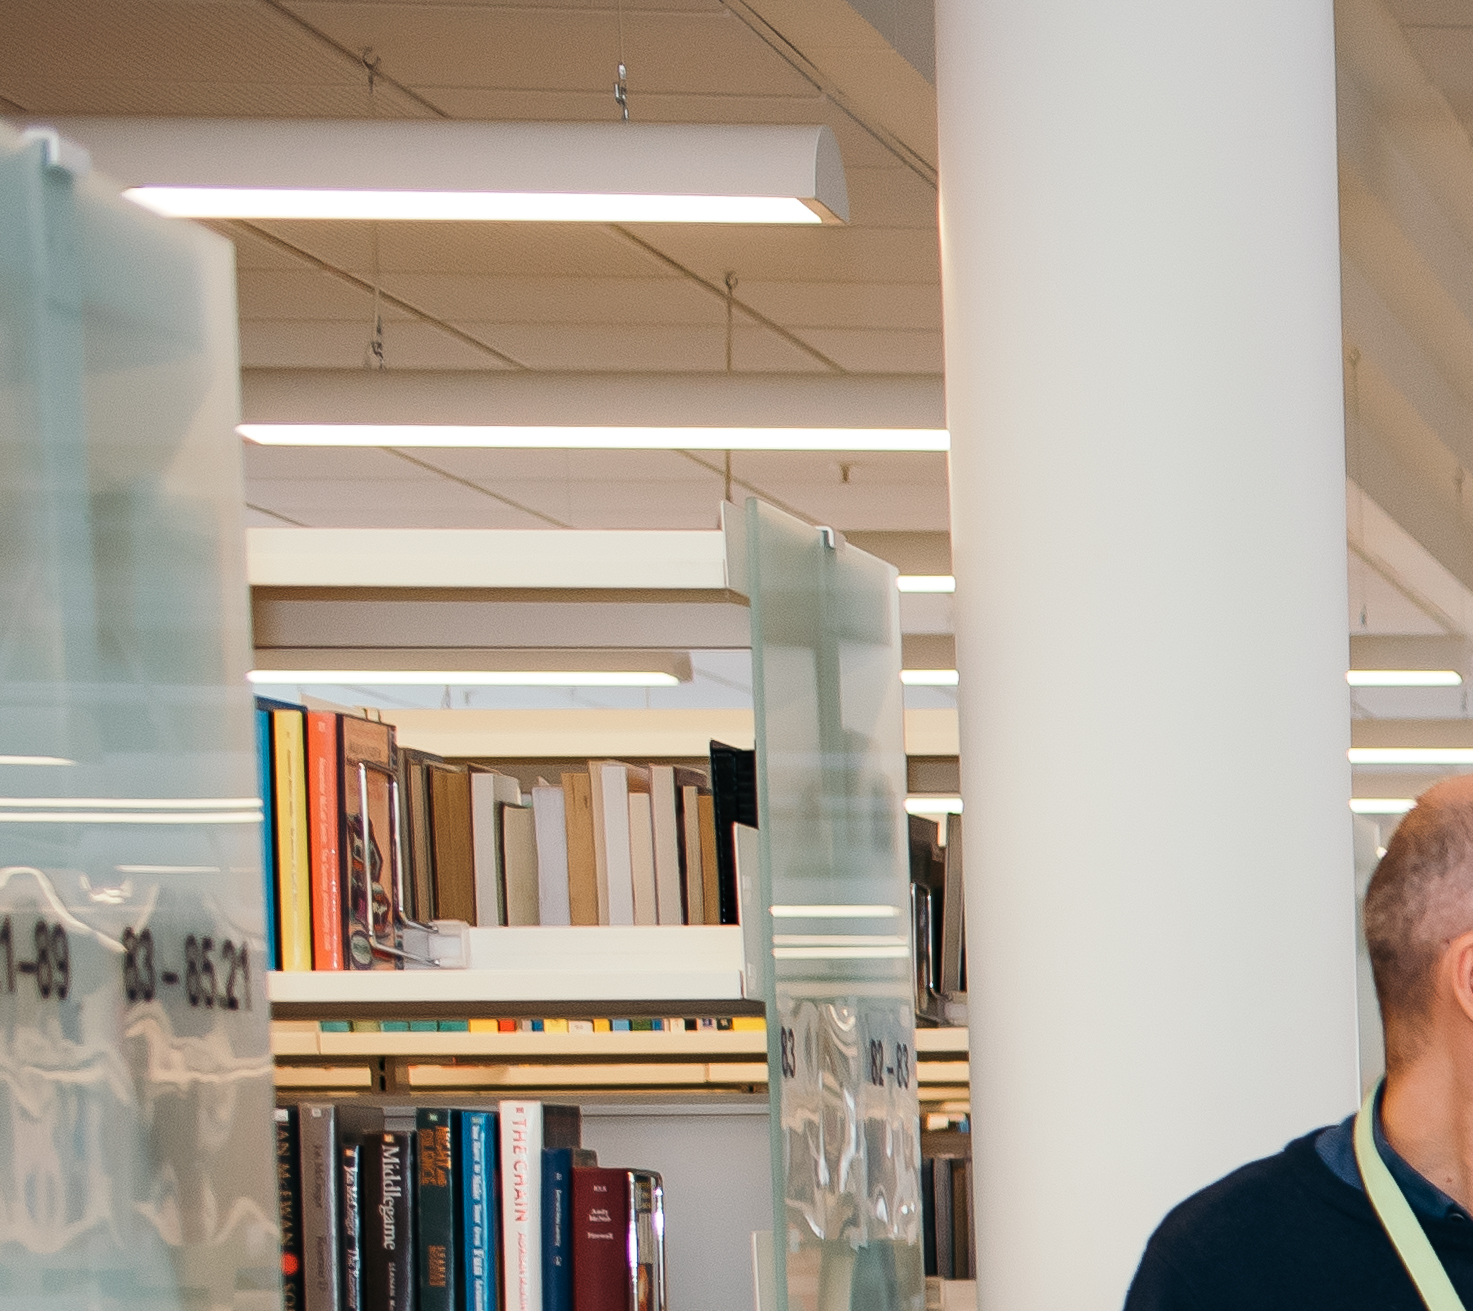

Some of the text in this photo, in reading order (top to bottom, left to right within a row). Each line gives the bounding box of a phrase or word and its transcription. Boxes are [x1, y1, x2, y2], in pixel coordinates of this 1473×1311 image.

[379, 1144, 401, 1251] Middlegame
[512, 1119, 528, 1222] THE CHAIN
